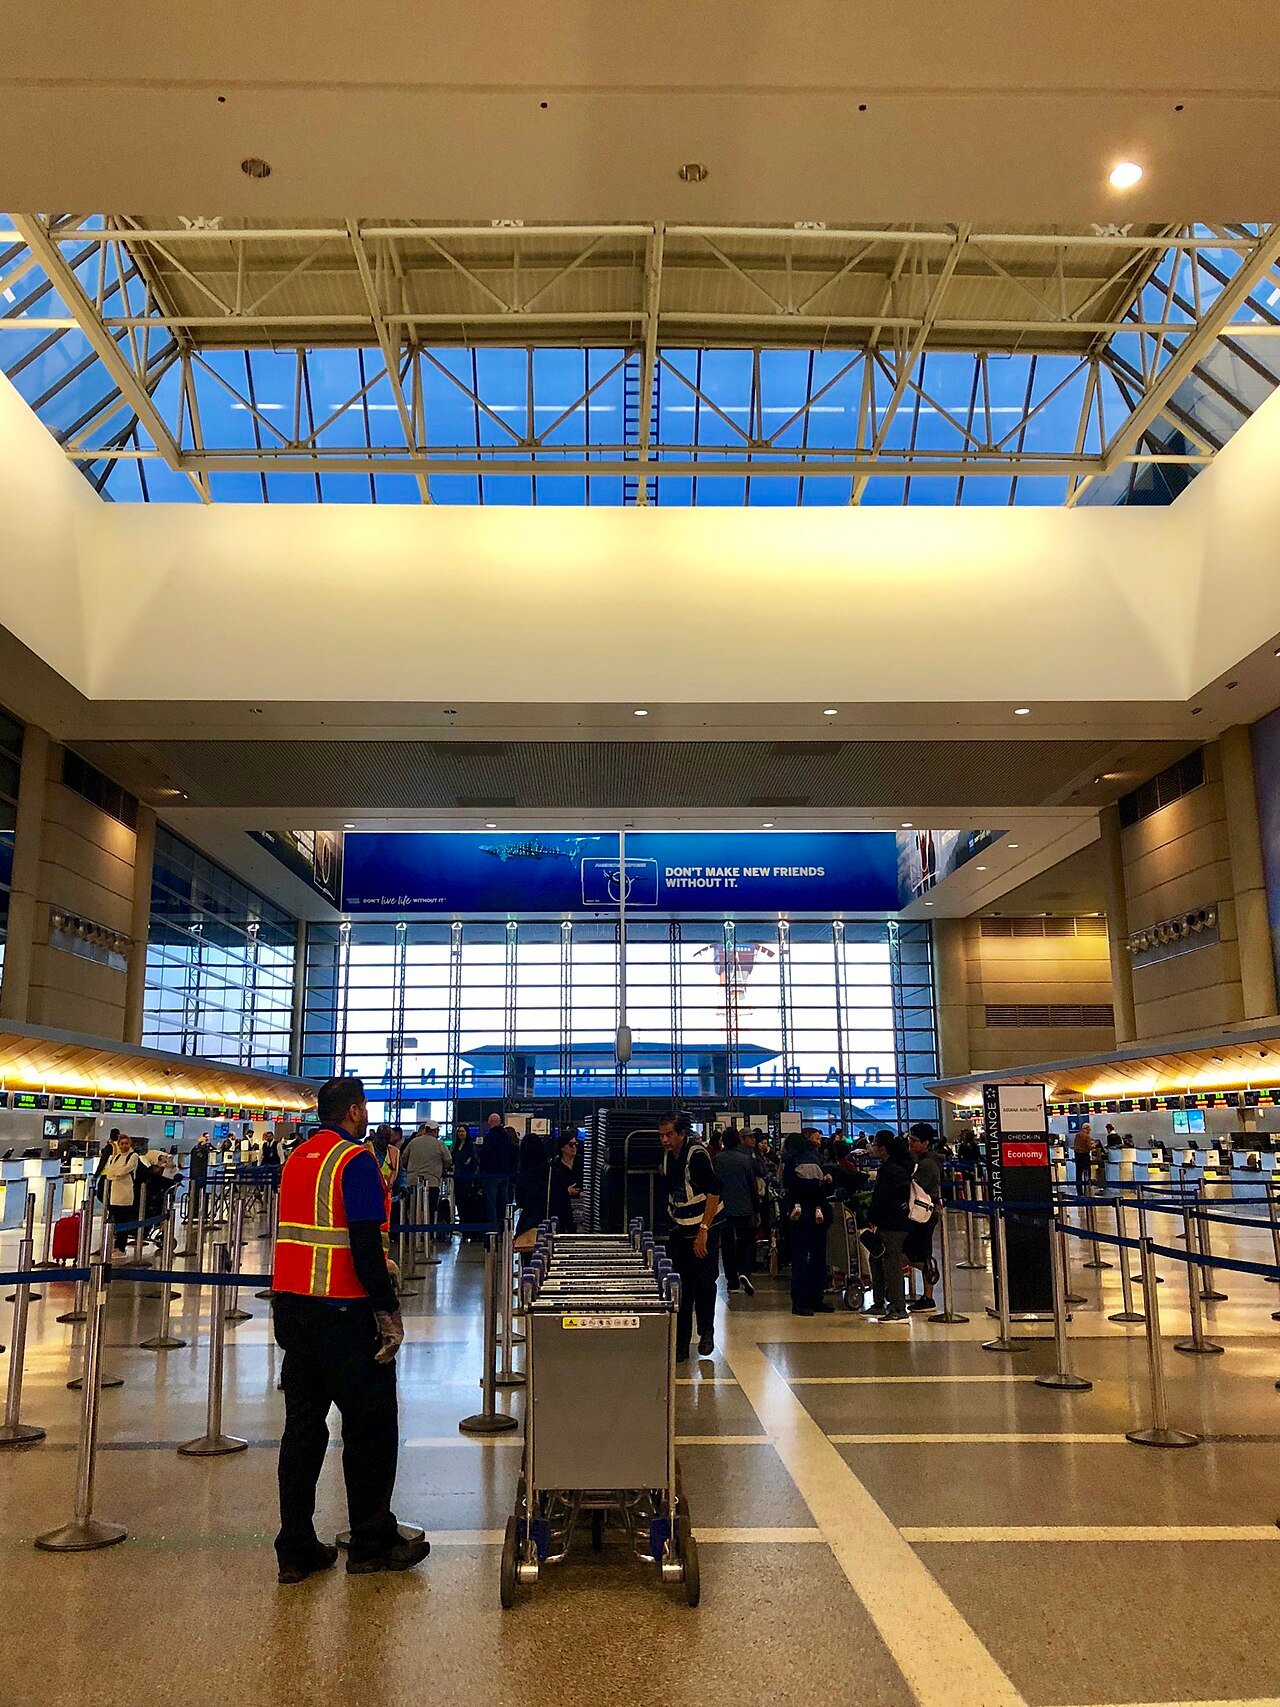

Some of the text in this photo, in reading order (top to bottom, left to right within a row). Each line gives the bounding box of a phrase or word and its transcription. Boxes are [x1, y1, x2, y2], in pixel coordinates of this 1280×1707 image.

[665, 867, 825, 877] DON'T MAKE NEW FRIENDS
[665, 878, 738, 888] WITHOUT IT.
[381, 895, 397, 905] live
[397, 895, 412, 906] life
[987, 1102, 1003, 1202] STAR ALLIANCE
[1007, 1150, 1043, 1160] Economy
